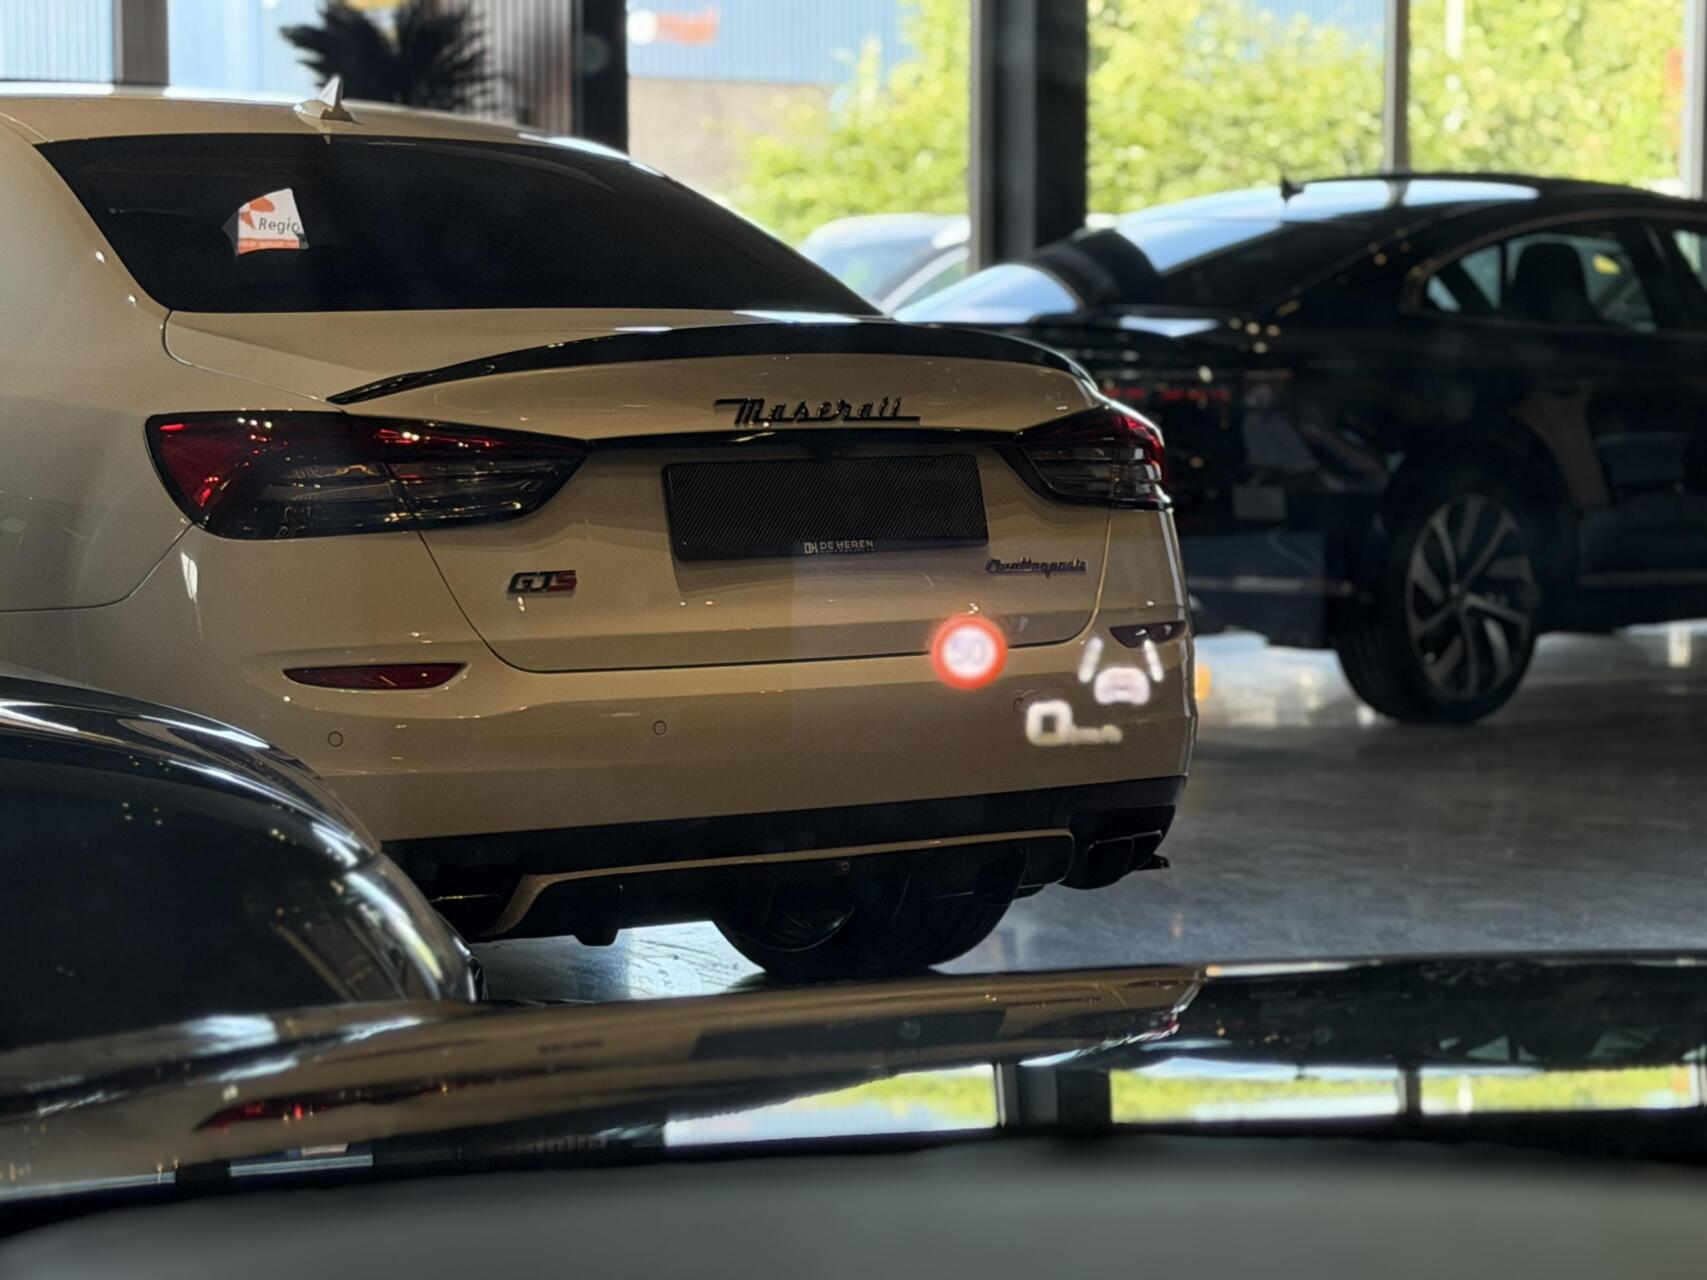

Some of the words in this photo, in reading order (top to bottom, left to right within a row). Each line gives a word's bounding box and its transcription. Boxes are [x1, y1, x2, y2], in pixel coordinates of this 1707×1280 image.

[714, 397, 921, 427] Maserati
[820, 541, 834, 550] DE
[836, 539, 874, 549] HEREN
[508, 570, 577, 593] GTS
